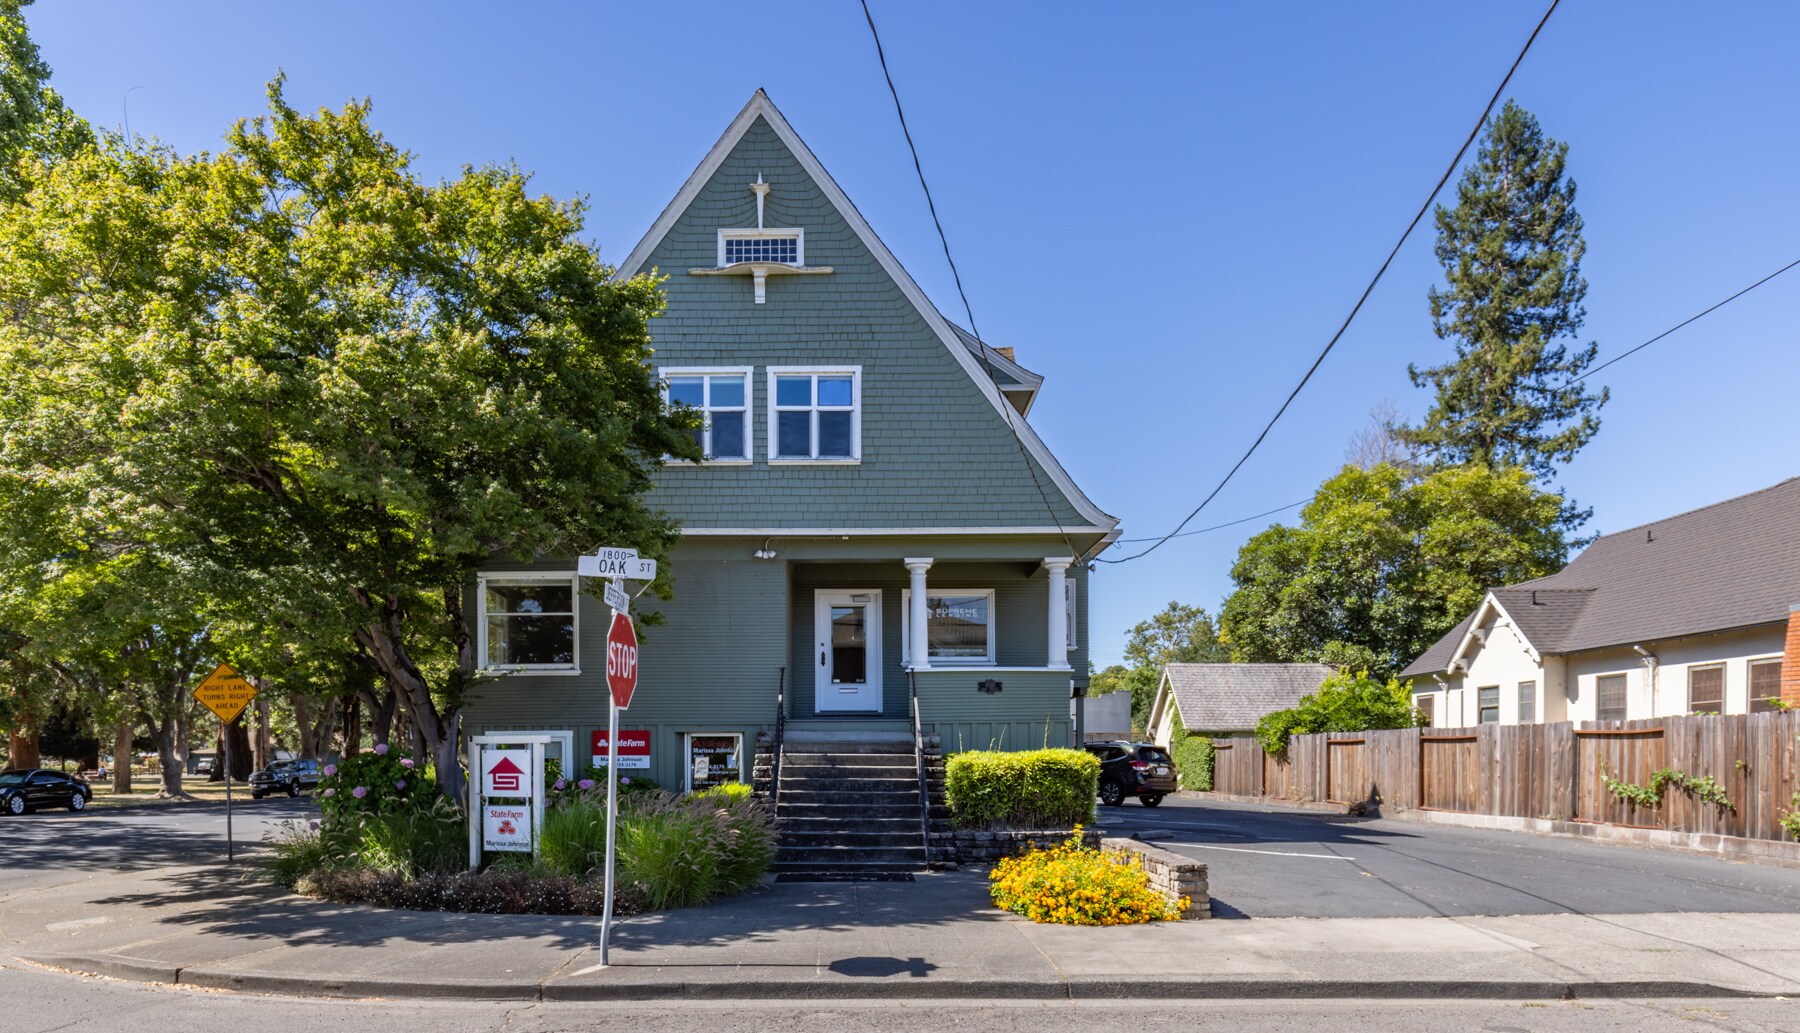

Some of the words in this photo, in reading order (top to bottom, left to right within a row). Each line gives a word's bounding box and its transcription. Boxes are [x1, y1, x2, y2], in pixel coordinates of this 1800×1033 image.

[603, 550, 627, 560] 1800
[599, 559, 627, 575] OAK
[640, 562, 651, 572] ST
[609, 640, 636, 680] STOP
[610, 739, 645, 747] ateFarm
[490, 809, 523, 819] StateFarm
[507, 840, 530, 848] Johnson
